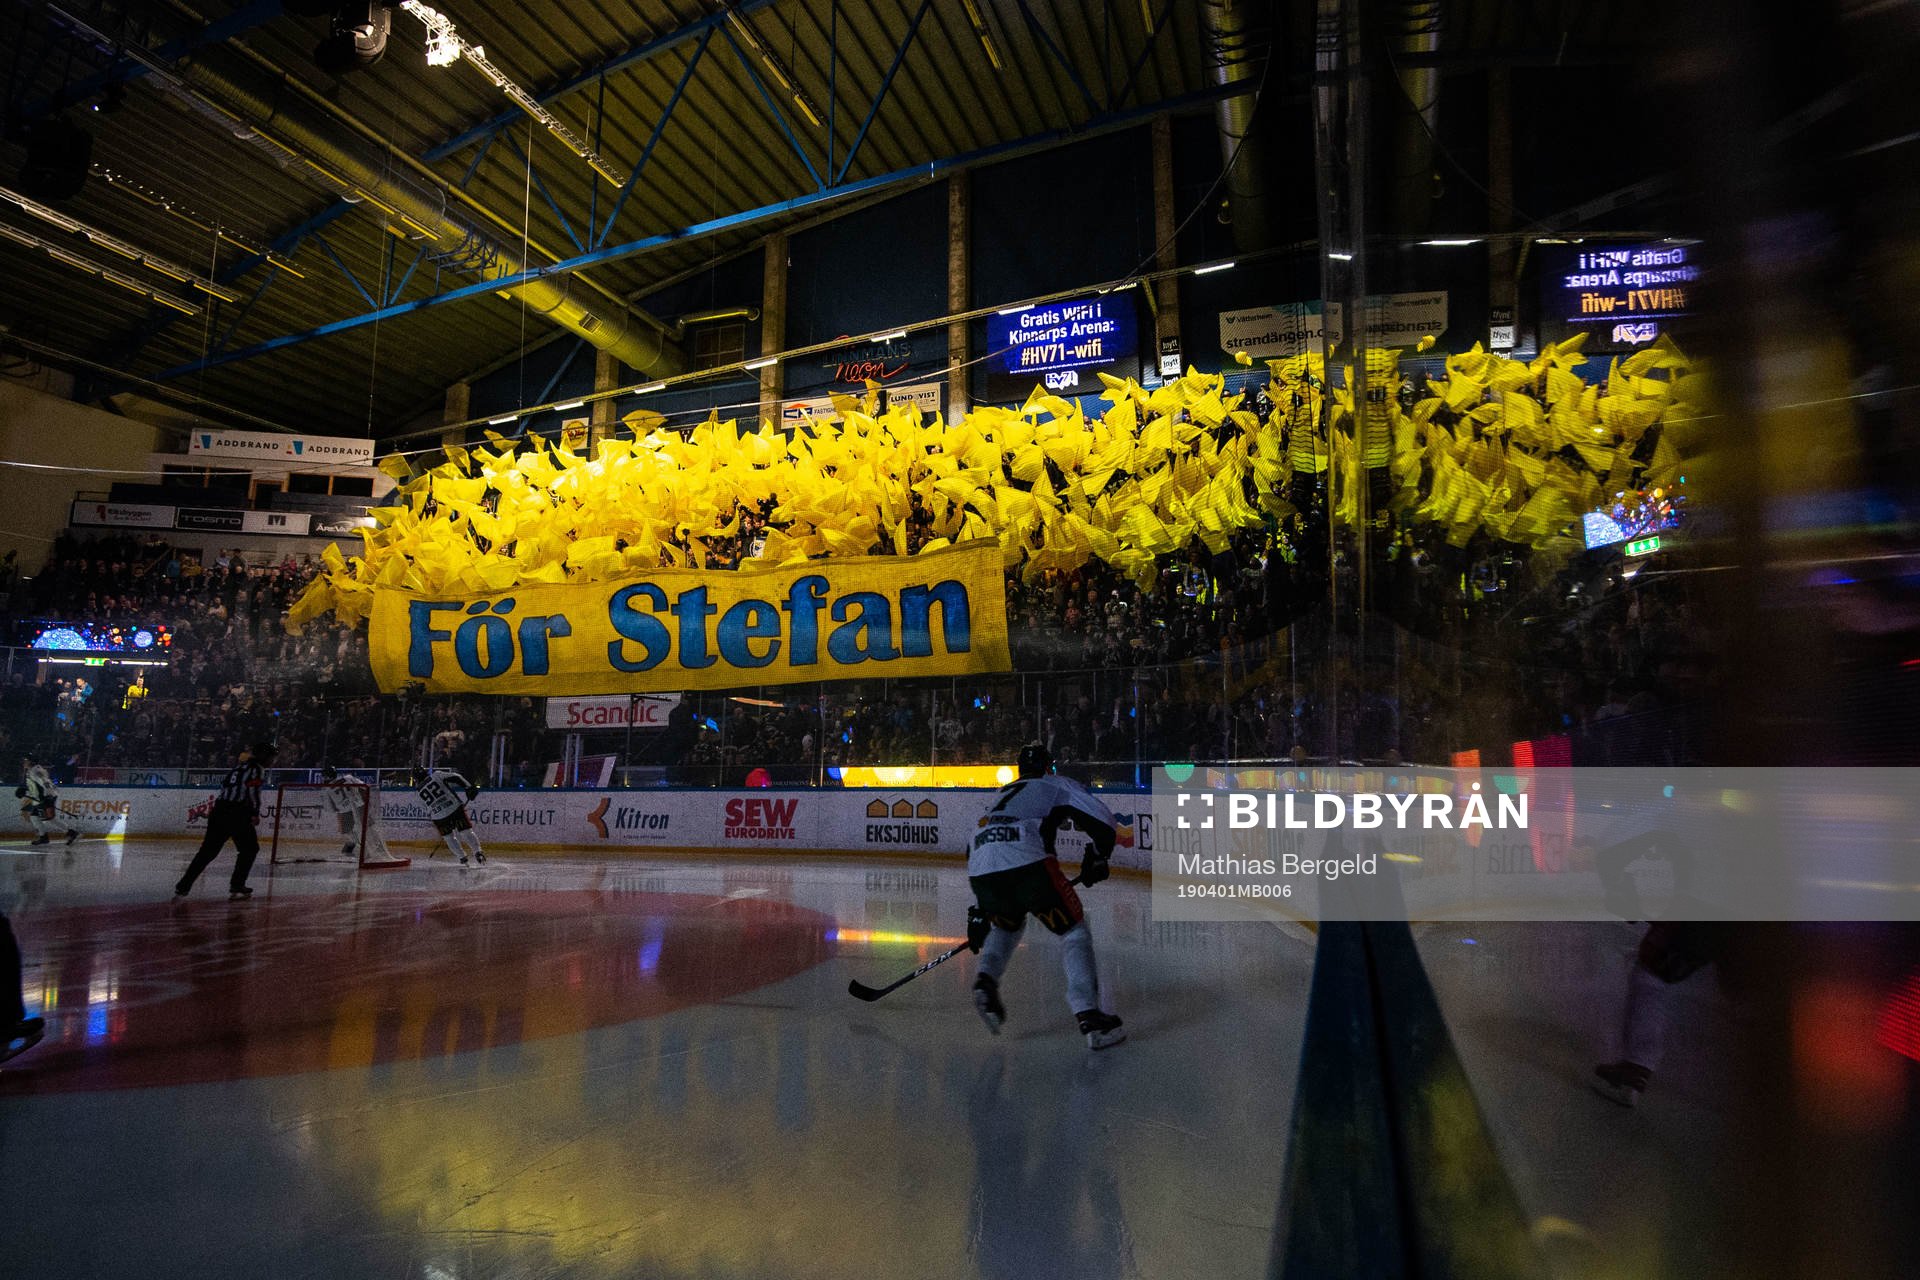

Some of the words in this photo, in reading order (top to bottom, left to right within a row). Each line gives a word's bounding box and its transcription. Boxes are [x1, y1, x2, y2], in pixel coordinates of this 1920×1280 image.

[1020, 310, 1060, 328] Gratis
[1063, 304, 1093, 322] WiFi
[1097, 304, 1102, 318] i
[1009, 325, 1068, 345] Kinnarps
[1070, 320, 1115, 337] Arena:
[1226, 327, 1325, 349] strandängen.c
[1020, 338, 1102, 366] #HV71-wifi
[890, 391, 936, 403] LUNDVIST
[215, 438, 280, 450] ADDBRAND
[307, 445, 371, 456] ADDBRAND
[407, 596, 573, 679] För
[606, 574, 972, 674] Stefan
[566, 699, 659, 725] Scandic
[419, 781, 446, 807] 92
[992, 781, 1028, 813] 7
[60, 799, 131, 815] BETONG
[469, 809, 556, 826] AGERHULT
[615, 806, 670, 829] Kitron
[723, 798, 799, 828] SEW
[724, 827, 796, 840] EURODRIVE
[865, 821, 939, 845] EKSJÖHUS
